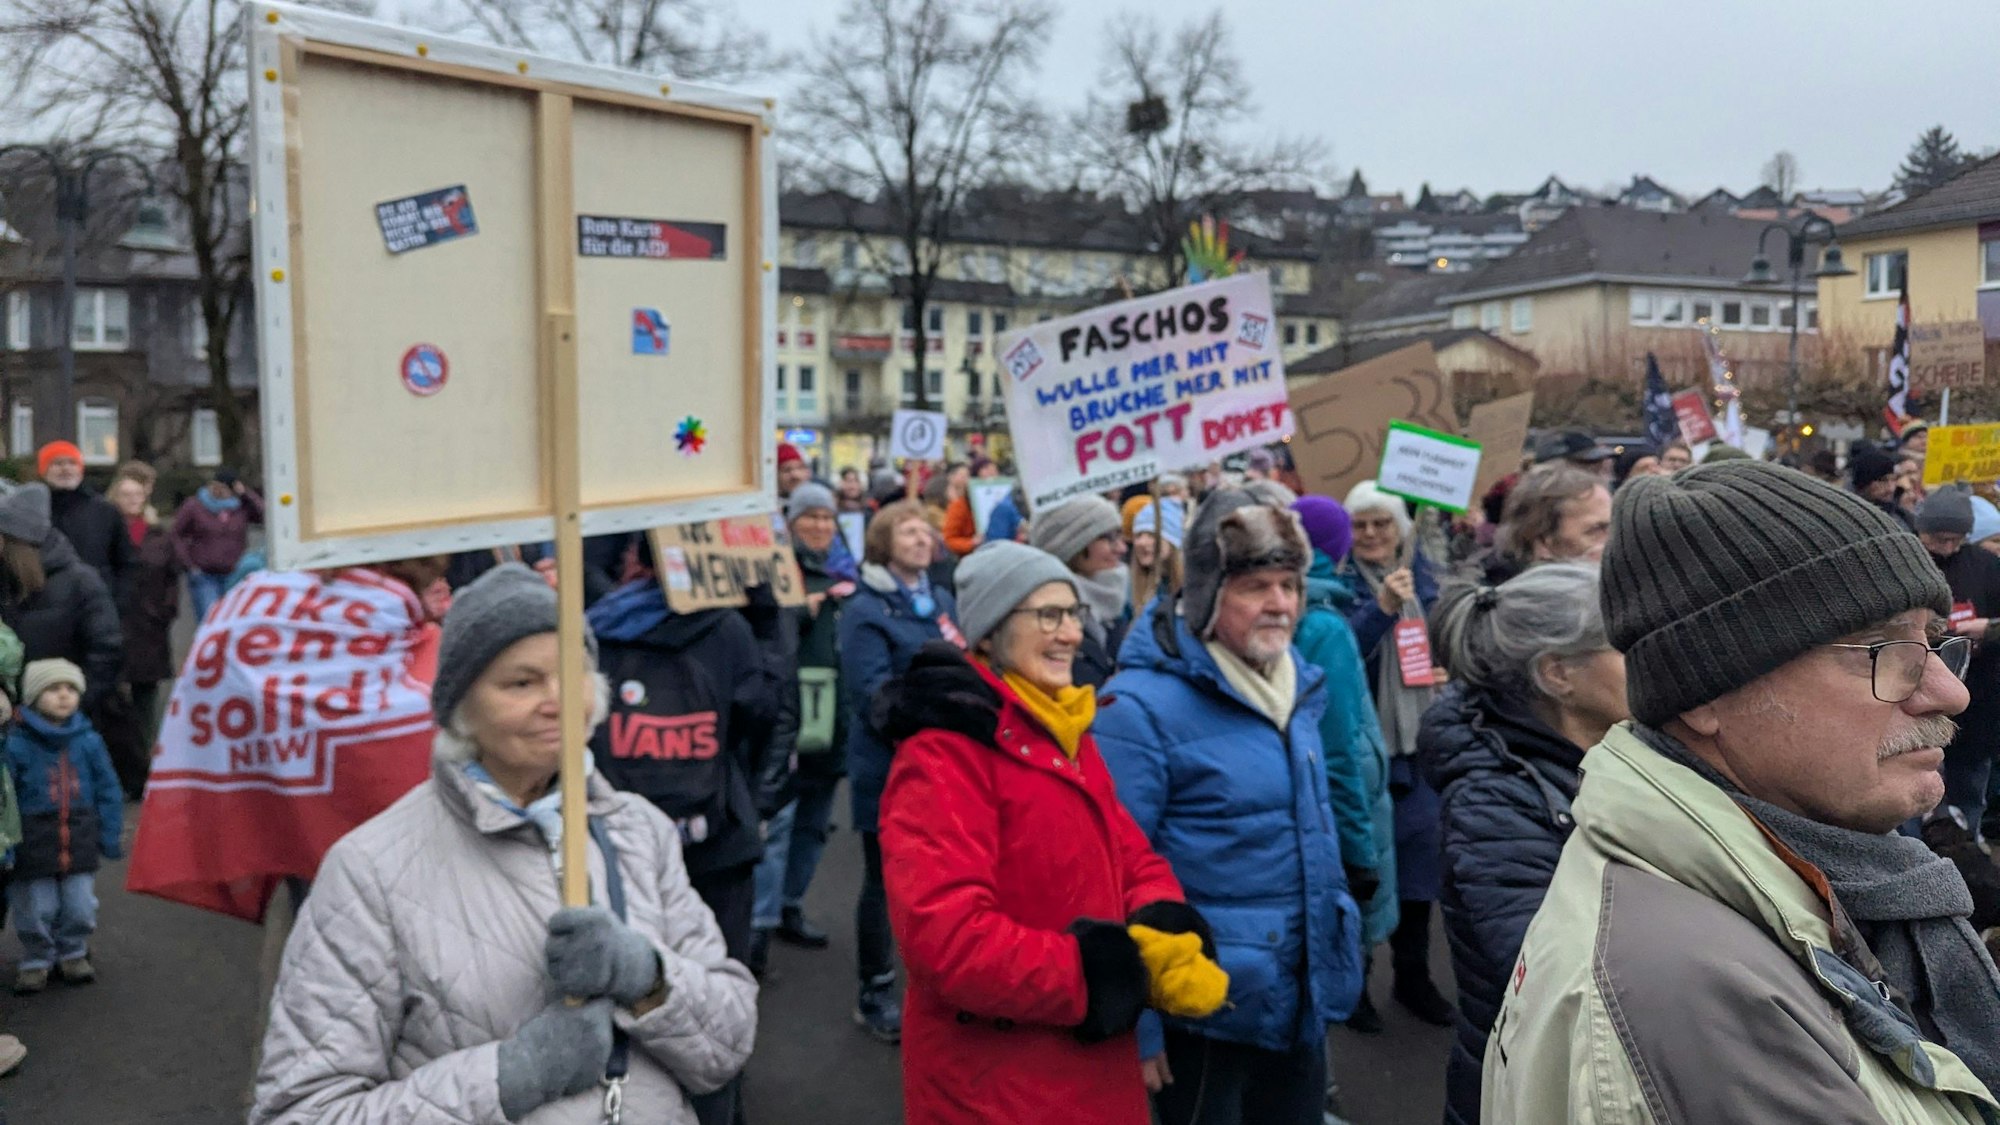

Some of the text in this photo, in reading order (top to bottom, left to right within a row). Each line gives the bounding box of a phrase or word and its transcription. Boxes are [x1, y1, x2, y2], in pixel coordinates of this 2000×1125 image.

[581, 216, 662, 238] Rote Karte
[609, 237, 634, 256] die
[1059, 297, 1229, 363] FASCHOS
[1037, 367, 1119, 407] WULLE
[1131, 354, 1178, 382] MER
[1070, 384, 1167, 431] BRUCHE
[1175, 370, 1223, 399] MER
[1075, 402, 1289, 476] FOTT DOMET
[229, 732, 310, 772] NRW
[610, 710, 719, 760] VANS
